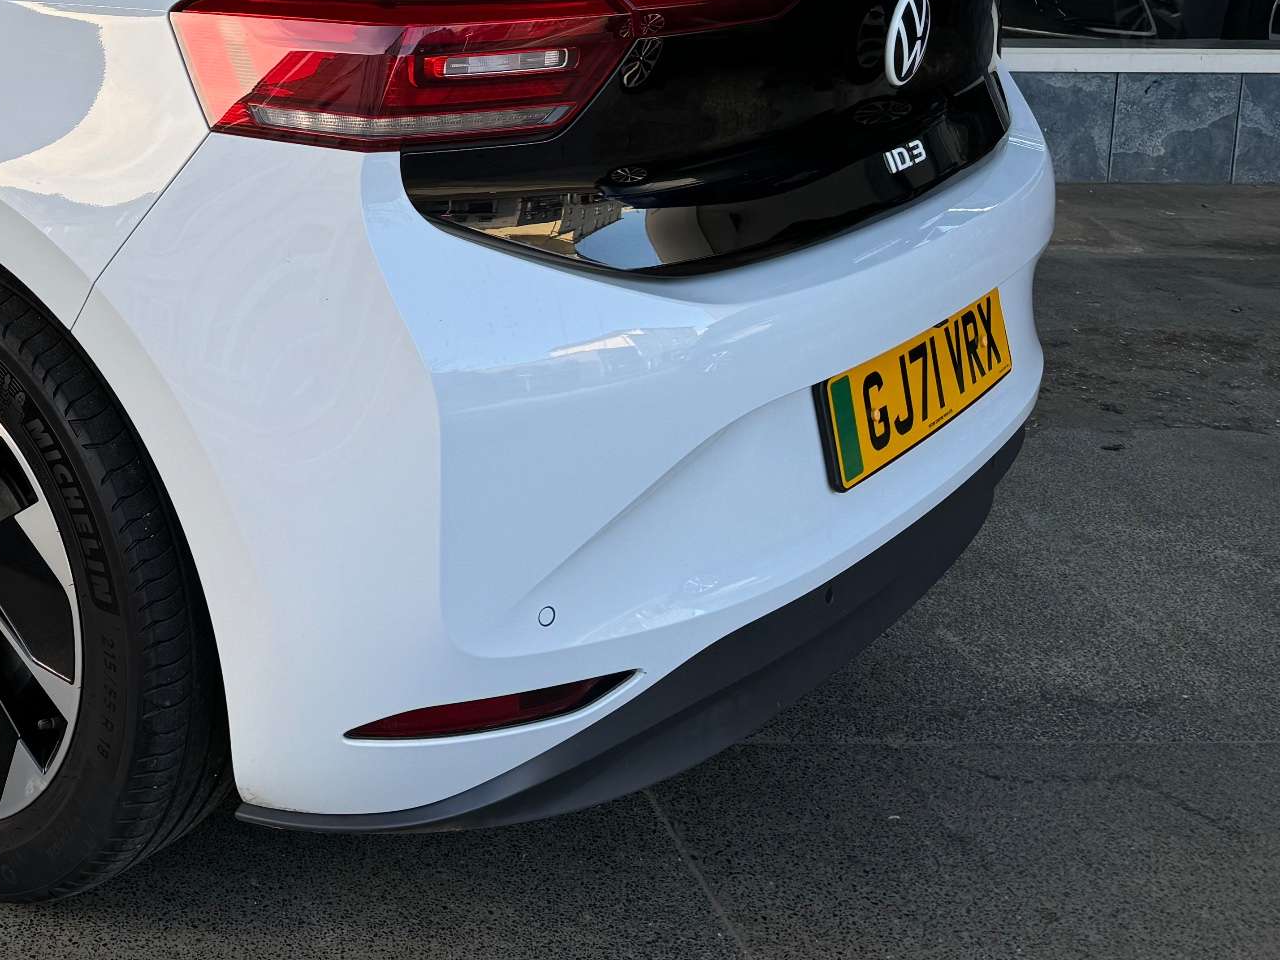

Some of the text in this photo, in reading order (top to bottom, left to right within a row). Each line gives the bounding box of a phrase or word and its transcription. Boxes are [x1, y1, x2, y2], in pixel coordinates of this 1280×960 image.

[862, 296, 1002, 451] GJ71 VRX
[25, 416, 114, 606] MICHELIN
